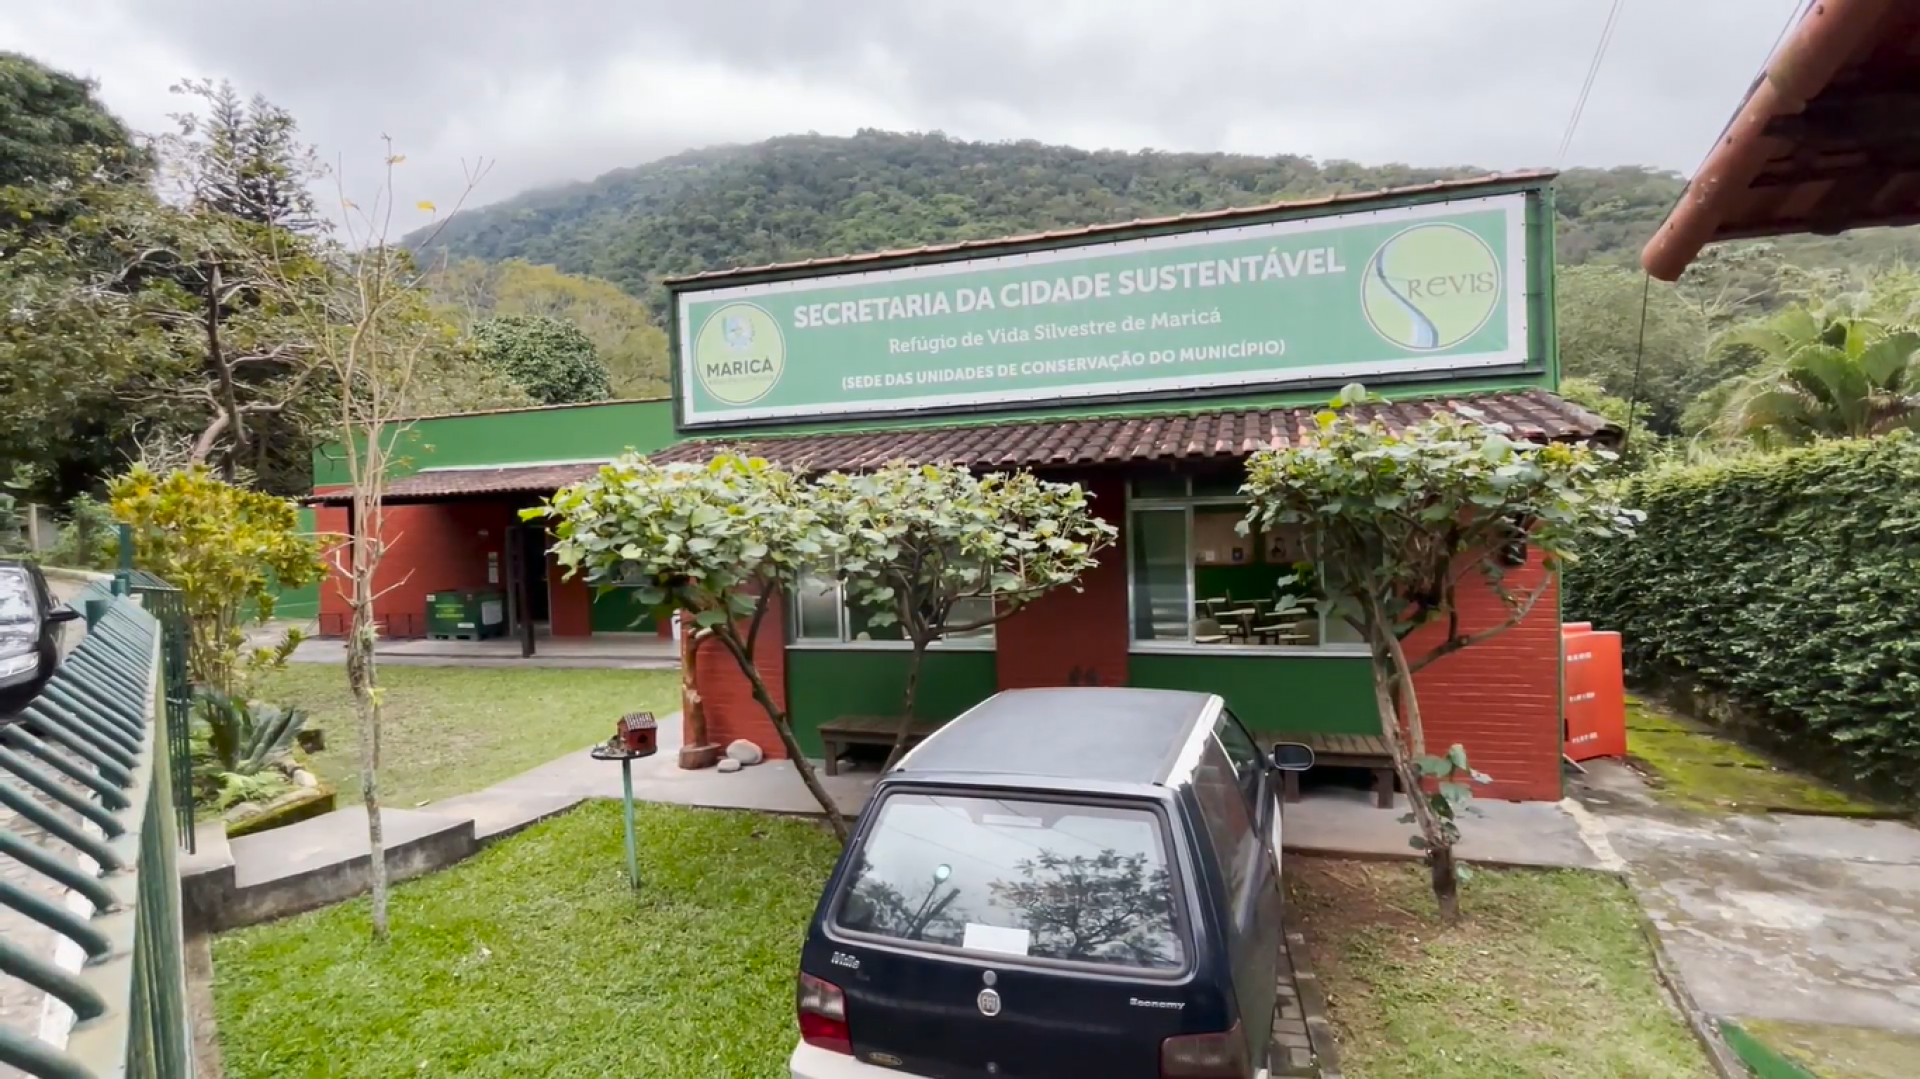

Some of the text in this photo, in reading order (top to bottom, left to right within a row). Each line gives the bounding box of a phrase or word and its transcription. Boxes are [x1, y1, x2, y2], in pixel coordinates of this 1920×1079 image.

[794, 247, 1346, 328] SECRETARIA DA CIDADE SUSTENTÁVEL
[889, 307, 1222, 355] Refúgio de Vida Silvestre de Maricá
[706, 355, 774, 378] MARICÁ
[842, 340, 1287, 390] (SEDE DAS UNIDADES DE CONSERVAÇÃO DO MUNICÍPIO)
[1129, 997, 1186, 1010] Economy
